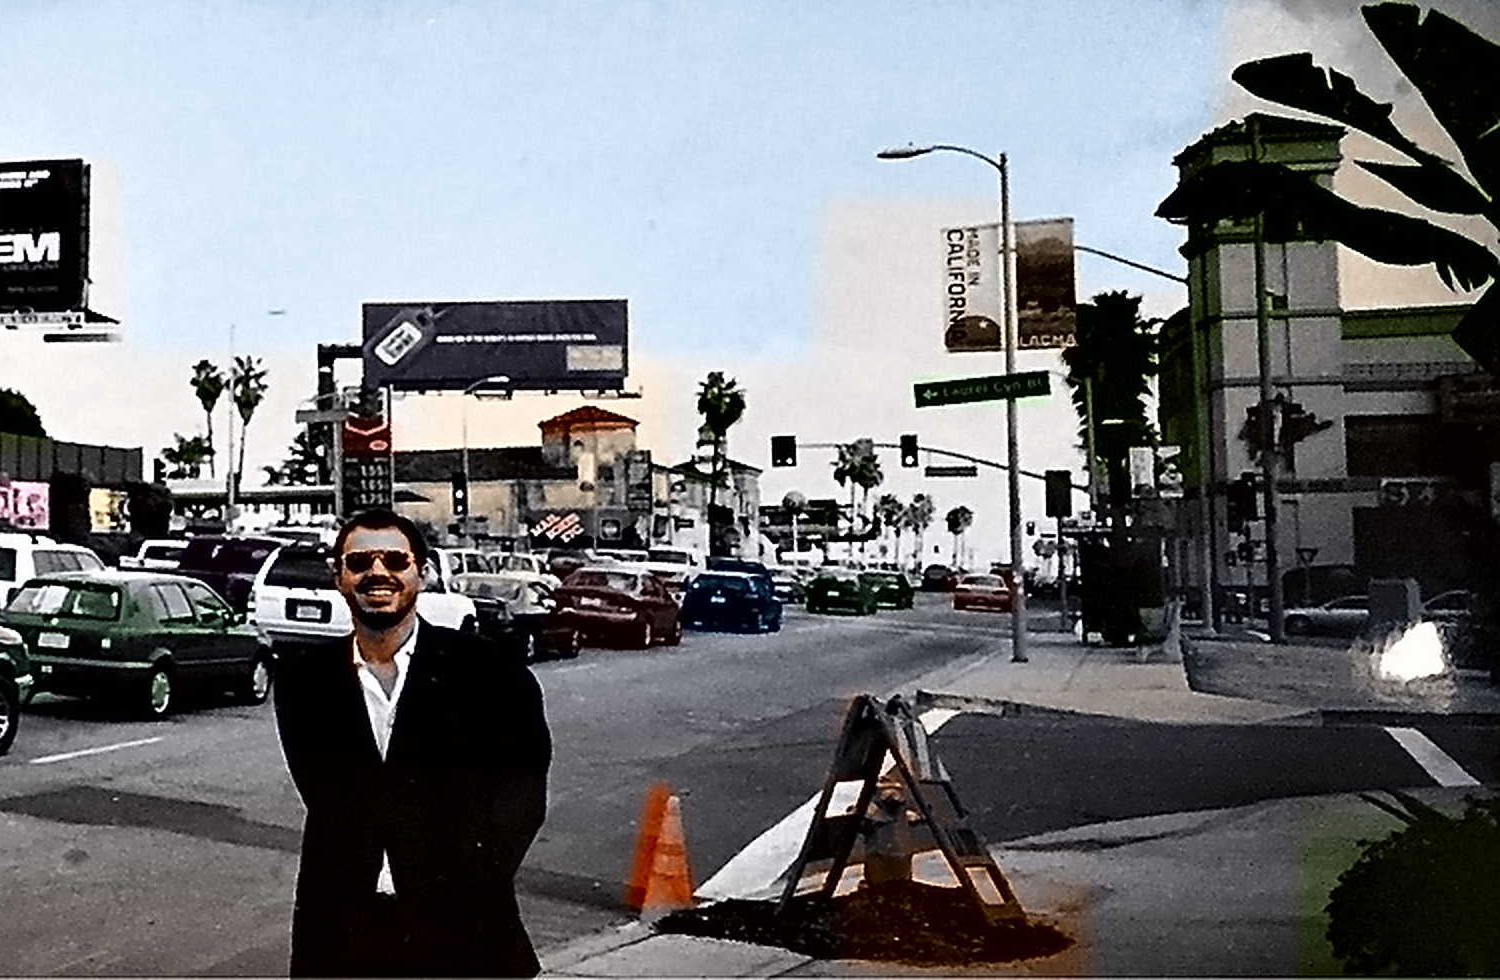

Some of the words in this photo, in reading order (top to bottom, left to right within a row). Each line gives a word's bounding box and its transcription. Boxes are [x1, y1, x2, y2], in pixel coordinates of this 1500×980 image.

[967, 228, 981, 267] MADE
[946, 229, 968, 340] CALIFORNIA
[968, 271, 980, 286] IN
[1019, 335, 1077, 347] LACMA
[943, 384, 989, 397] Laurel
[993, 380, 1022, 395] Cyn
